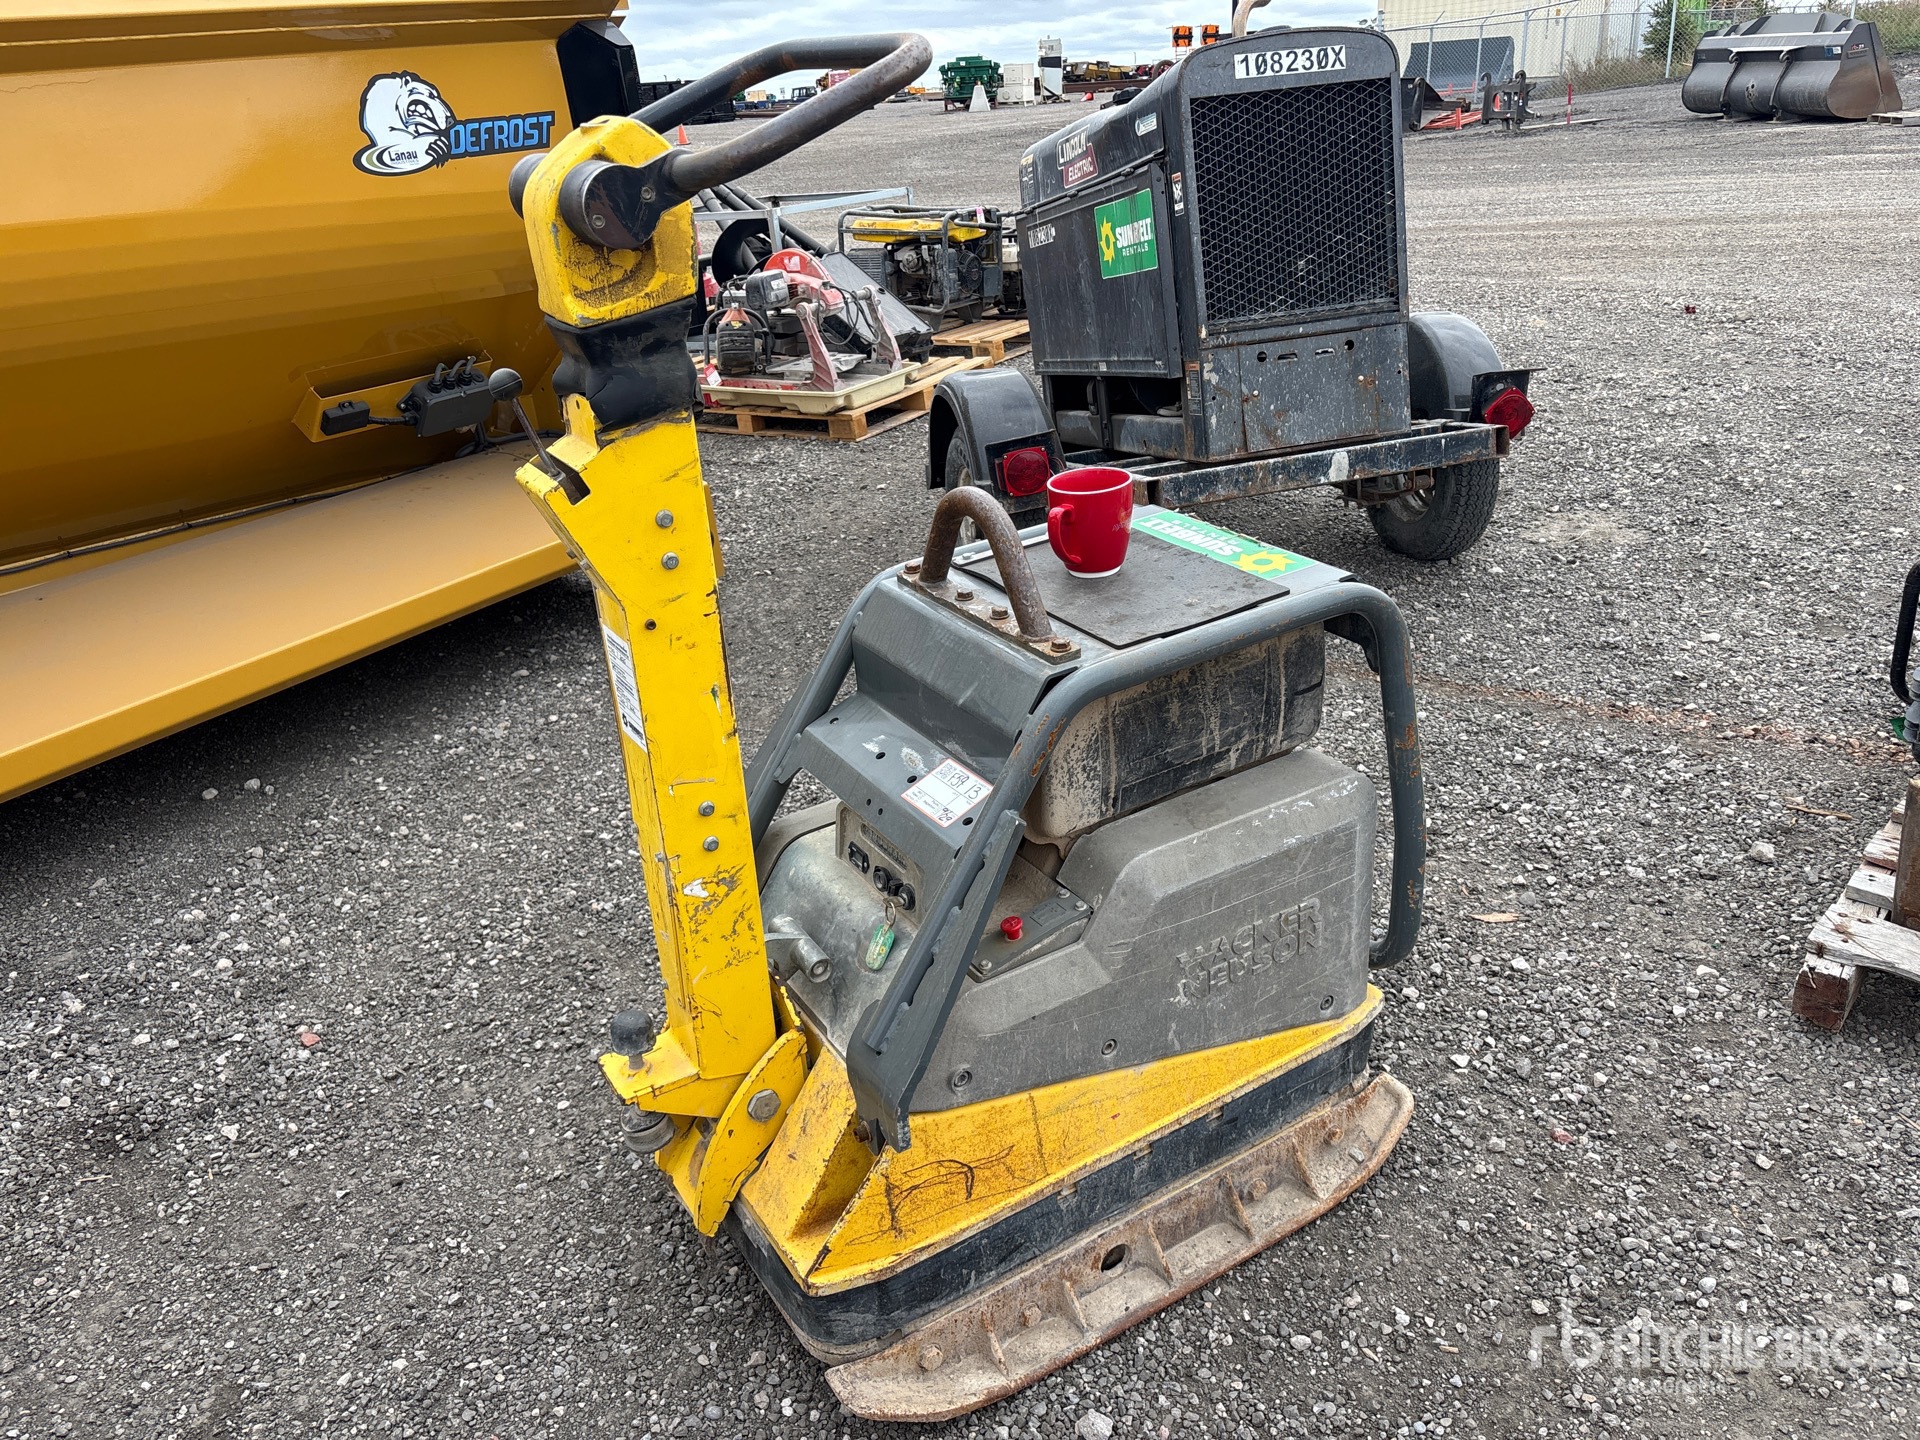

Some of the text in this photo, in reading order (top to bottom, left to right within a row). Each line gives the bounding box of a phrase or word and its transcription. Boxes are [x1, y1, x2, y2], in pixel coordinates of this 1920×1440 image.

[450, 115, 552, 155] DEFROST
[388, 150, 418, 161] Lanau
[1068, 157, 1094, 181] ELECTRIC
[1115, 217, 1152, 248] SUNBELT
[1122, 242, 1149, 257] RENTALS
[1138, 518, 1243, 556] SUNBELT
[963, 783, 982, 799] 13
[1175, 897, 1321, 973] WACKER
[1179, 922, 1321, 999] NEUSON
